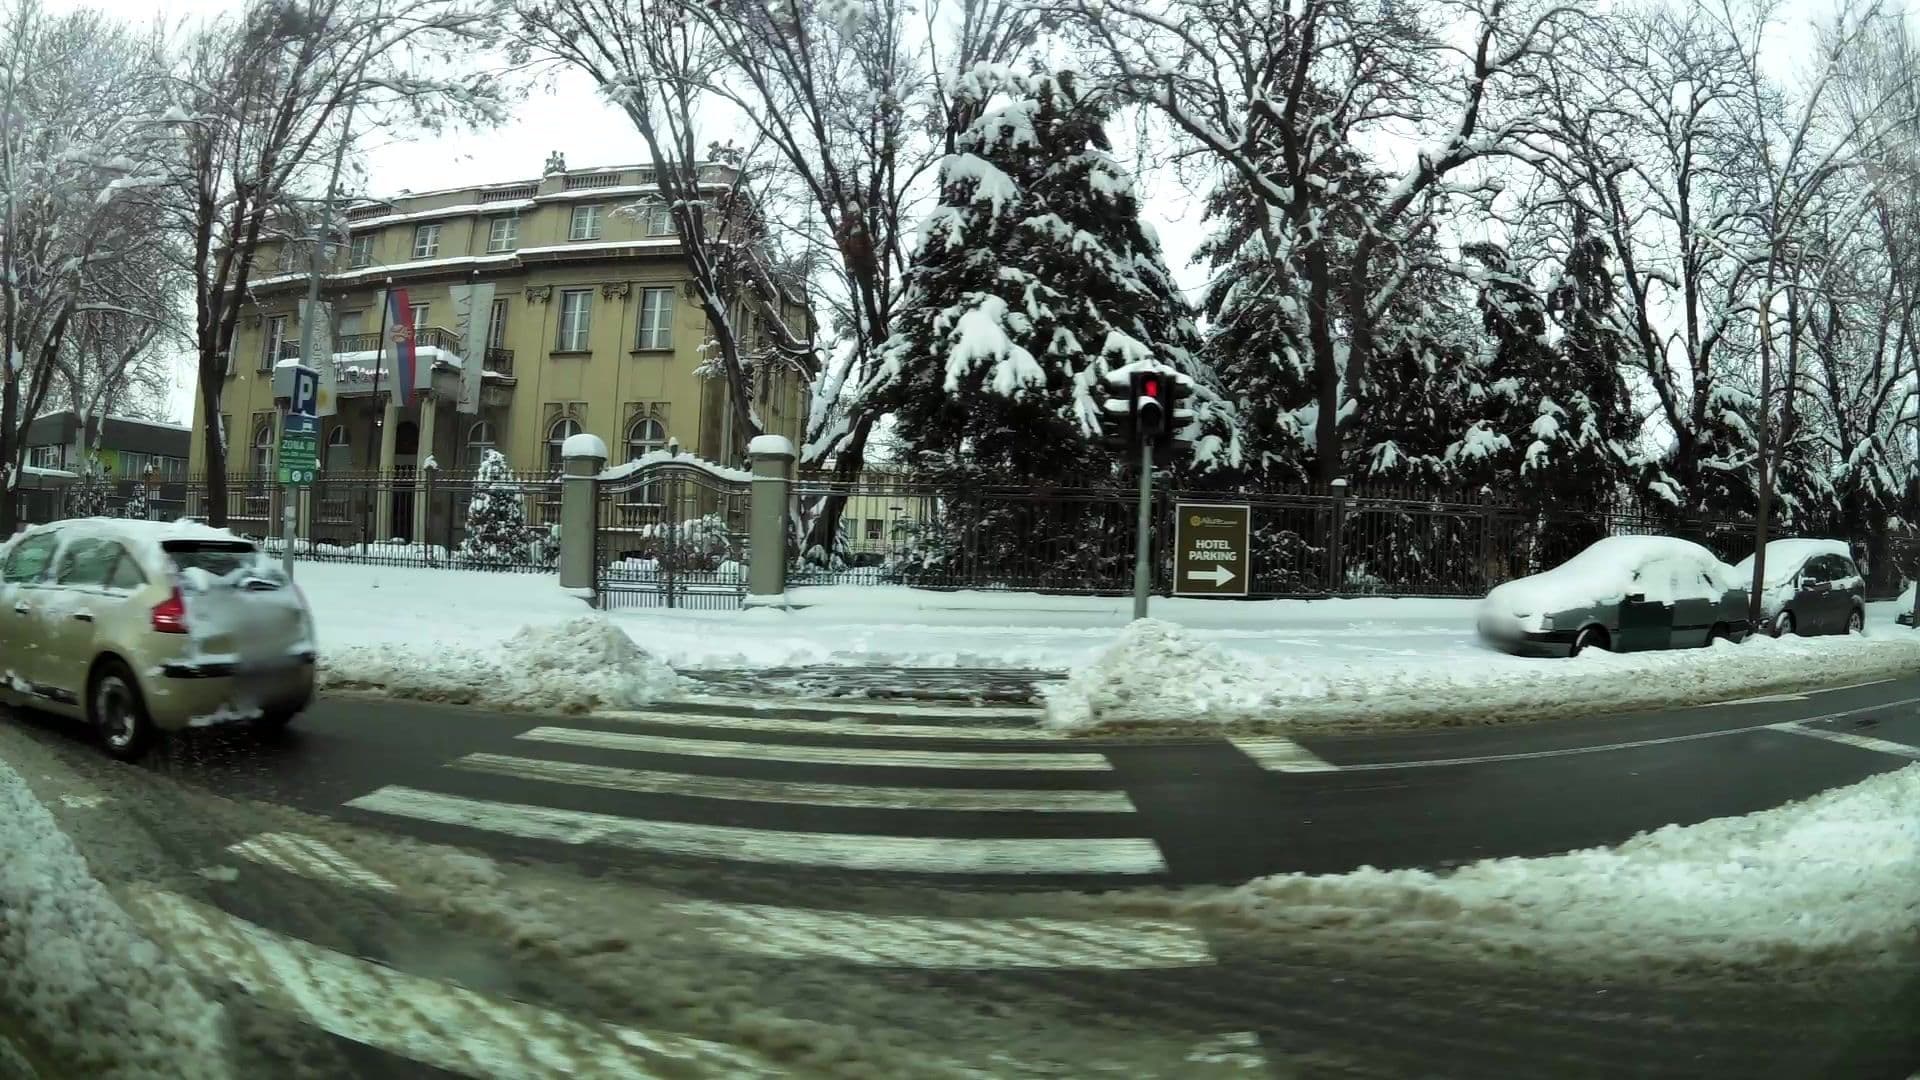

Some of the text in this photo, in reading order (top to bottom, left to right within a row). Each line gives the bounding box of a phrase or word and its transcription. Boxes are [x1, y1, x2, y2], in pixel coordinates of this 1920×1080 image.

[299, 374, 313, 408] P
[282, 440, 304, 450] ZONA
[1195, 539, 1232, 549] HOTEL
[1189, 551, 1237, 561] PARKING
